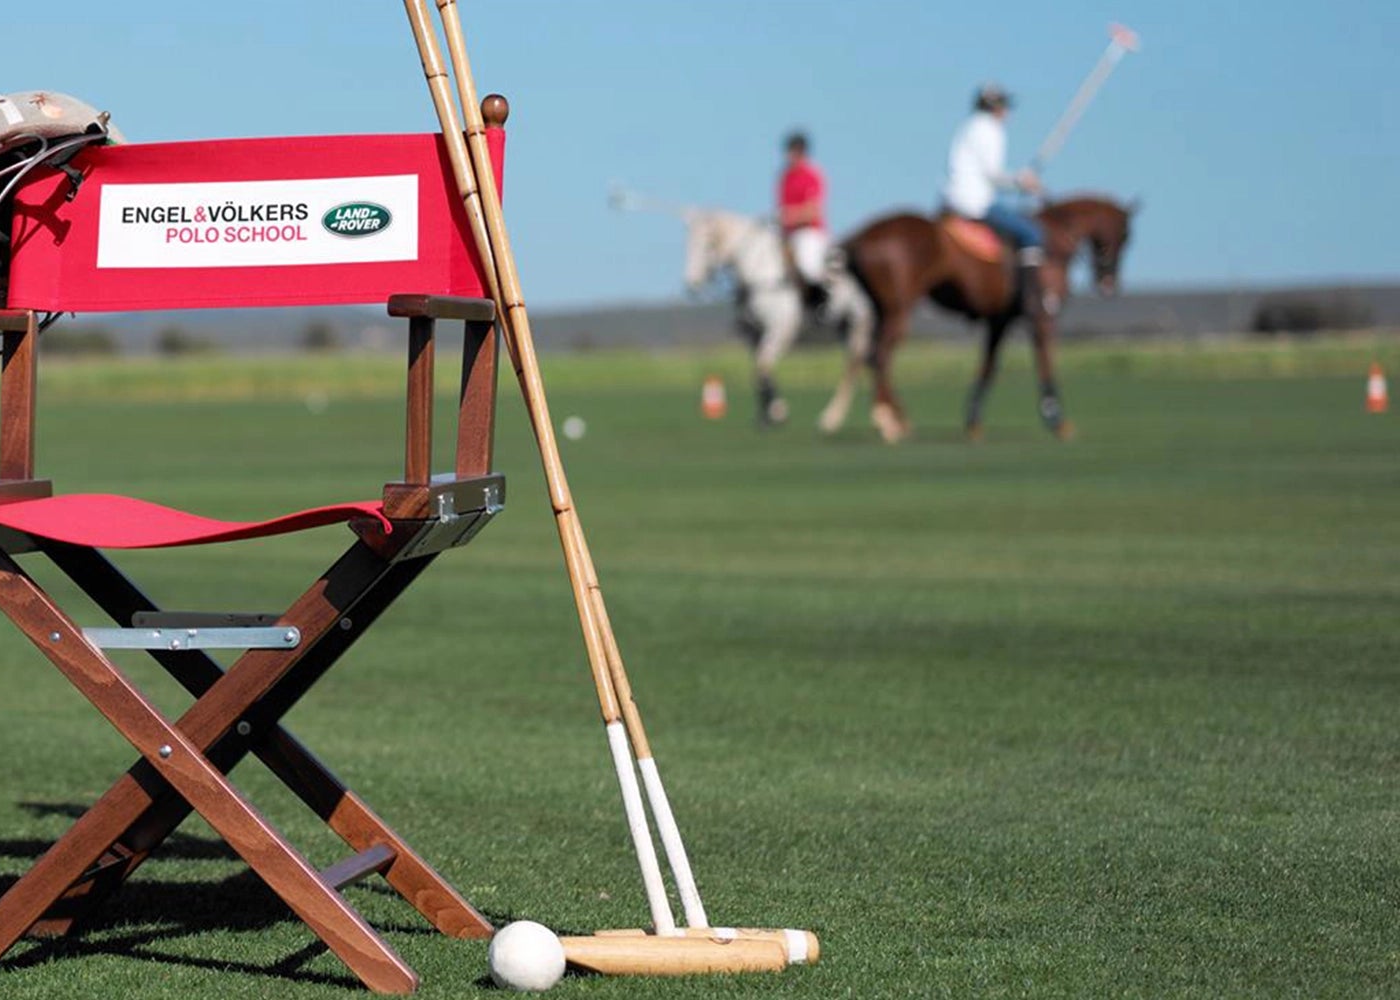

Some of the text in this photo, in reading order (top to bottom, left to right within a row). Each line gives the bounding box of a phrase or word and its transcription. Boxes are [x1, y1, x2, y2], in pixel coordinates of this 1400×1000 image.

[121, 201, 309, 224] ENGEL&VÖLKERS
[335, 208, 371, 219] LAND
[337, 218, 382, 231] ROVER
[165, 225, 308, 244] POLO SCHOOL
